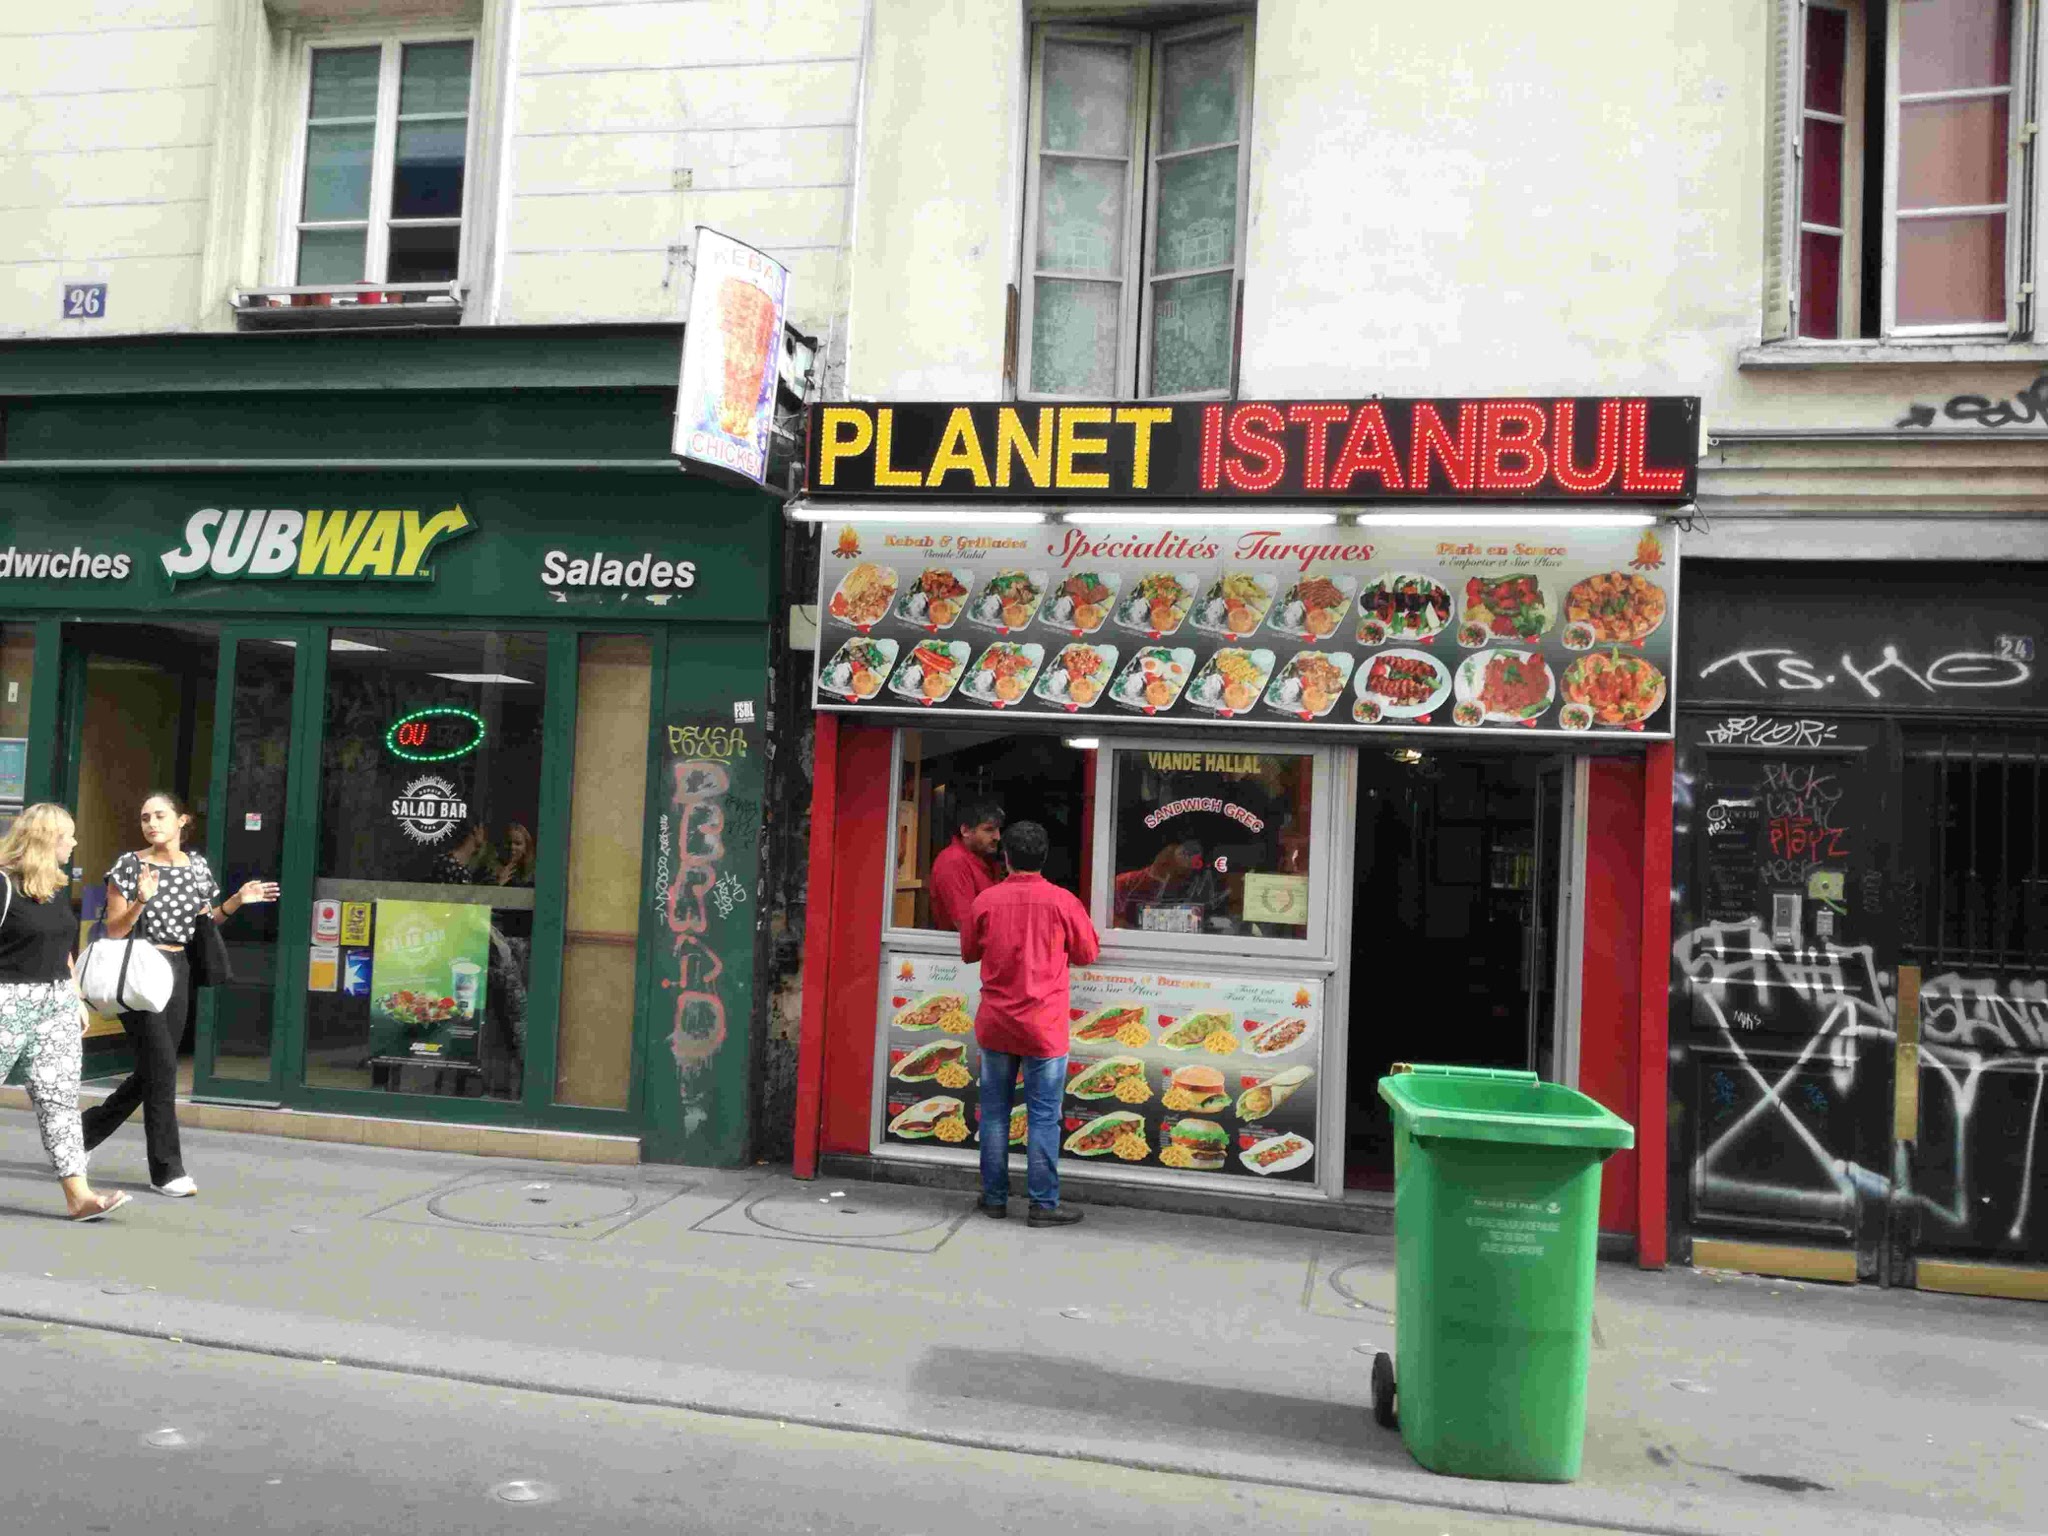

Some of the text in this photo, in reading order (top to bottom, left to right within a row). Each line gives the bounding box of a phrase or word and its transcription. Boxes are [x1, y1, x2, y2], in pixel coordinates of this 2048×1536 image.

[69, 289, 99, 315] 26
[692, 433, 763, 479] CHICKEN
[819, 402, 1684, 491] PLANET ISTANBUL
[160, 503, 468, 577] SUBWAY
[884, 534, 934, 548] Kebab
[956, 536, 1028, 549] Grillades
[1048, 529, 1375, 572] Spécialités Turques
[541, 551, 697, 588] Salades
[2000, 635, 2026, 659] 24
[1149, 752, 1261, 774] VIANDE HALLAL
[392, 800, 467, 819] SALAD BAR
[1144, 797, 1265, 833] SANDWICH GREC
